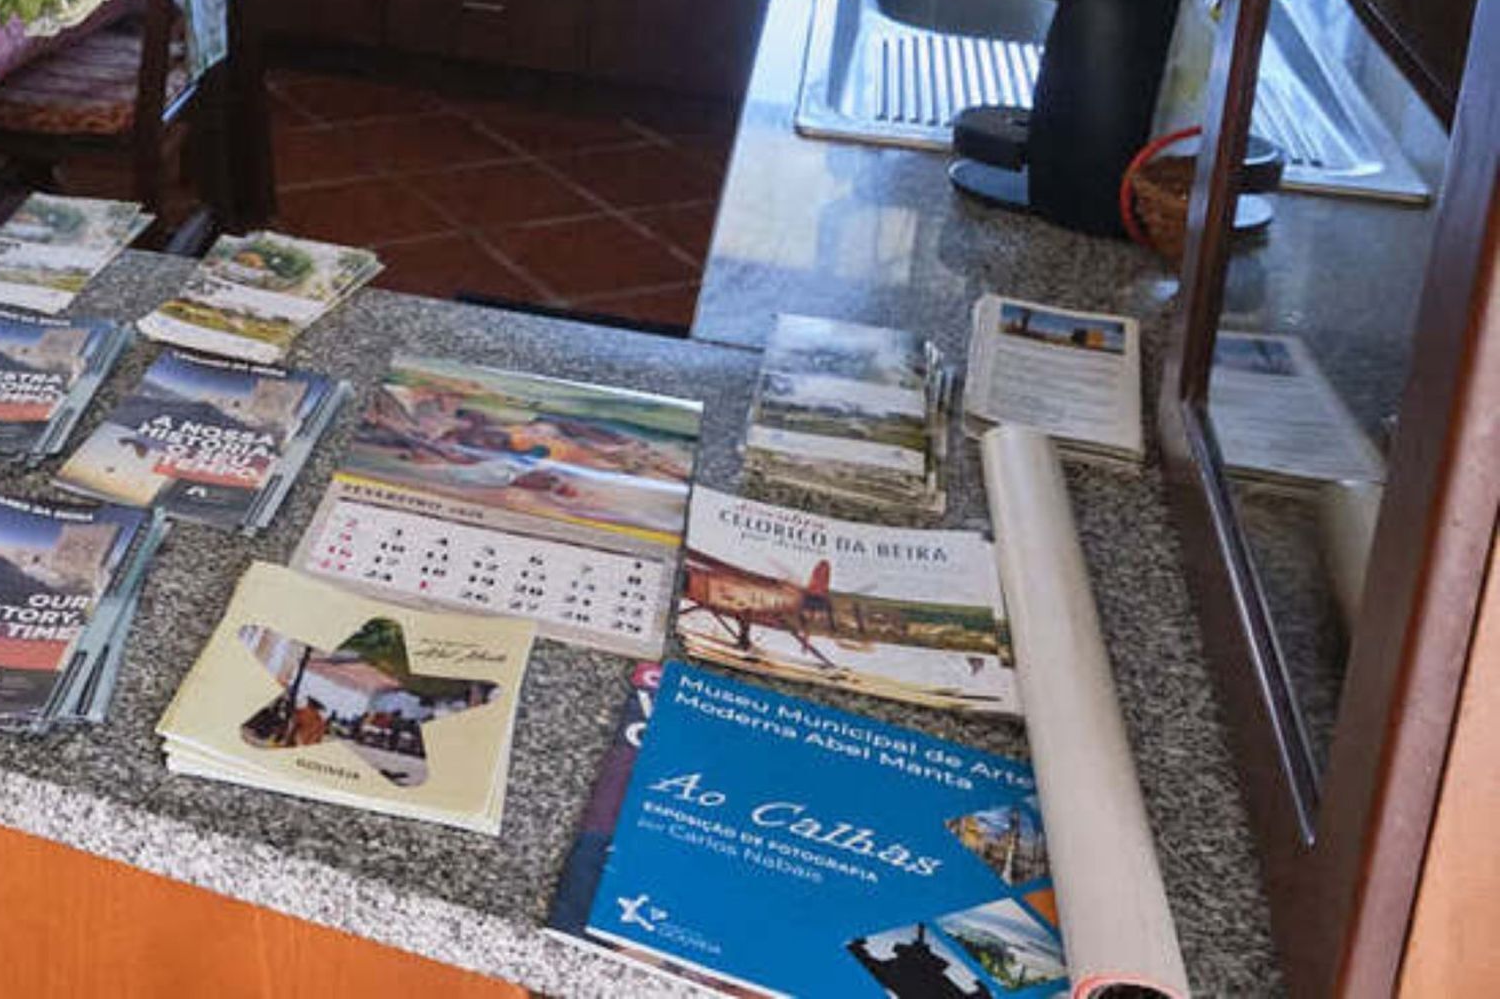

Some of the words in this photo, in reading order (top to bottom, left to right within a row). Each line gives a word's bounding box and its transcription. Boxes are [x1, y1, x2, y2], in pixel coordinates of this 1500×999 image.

[152, 415, 173, 429] A
[180, 421, 275, 446] NOSSA
[717, 508, 828, 548] CELORICO
[836, 535, 867, 555] DA
[876, 542, 950, 564] BEIRA
[28, 594, 92, 611] OUR
[674, 691, 798, 739] Moderna
[804, 732, 871, 760] Abel
[878, 752, 974, 790] Manta
[678, 675, 770, 714] Museu
[777, 704, 918, 757] Municipal
[925, 747, 963, 769] de
[970, 761, 1035, 788] Arte
[647, 772, 727, 806] Ao
[668, 823, 738, 857] Carlos
[740, 831, 765, 848] DE
[767, 840, 879, 883] FOTOGRAFIA
